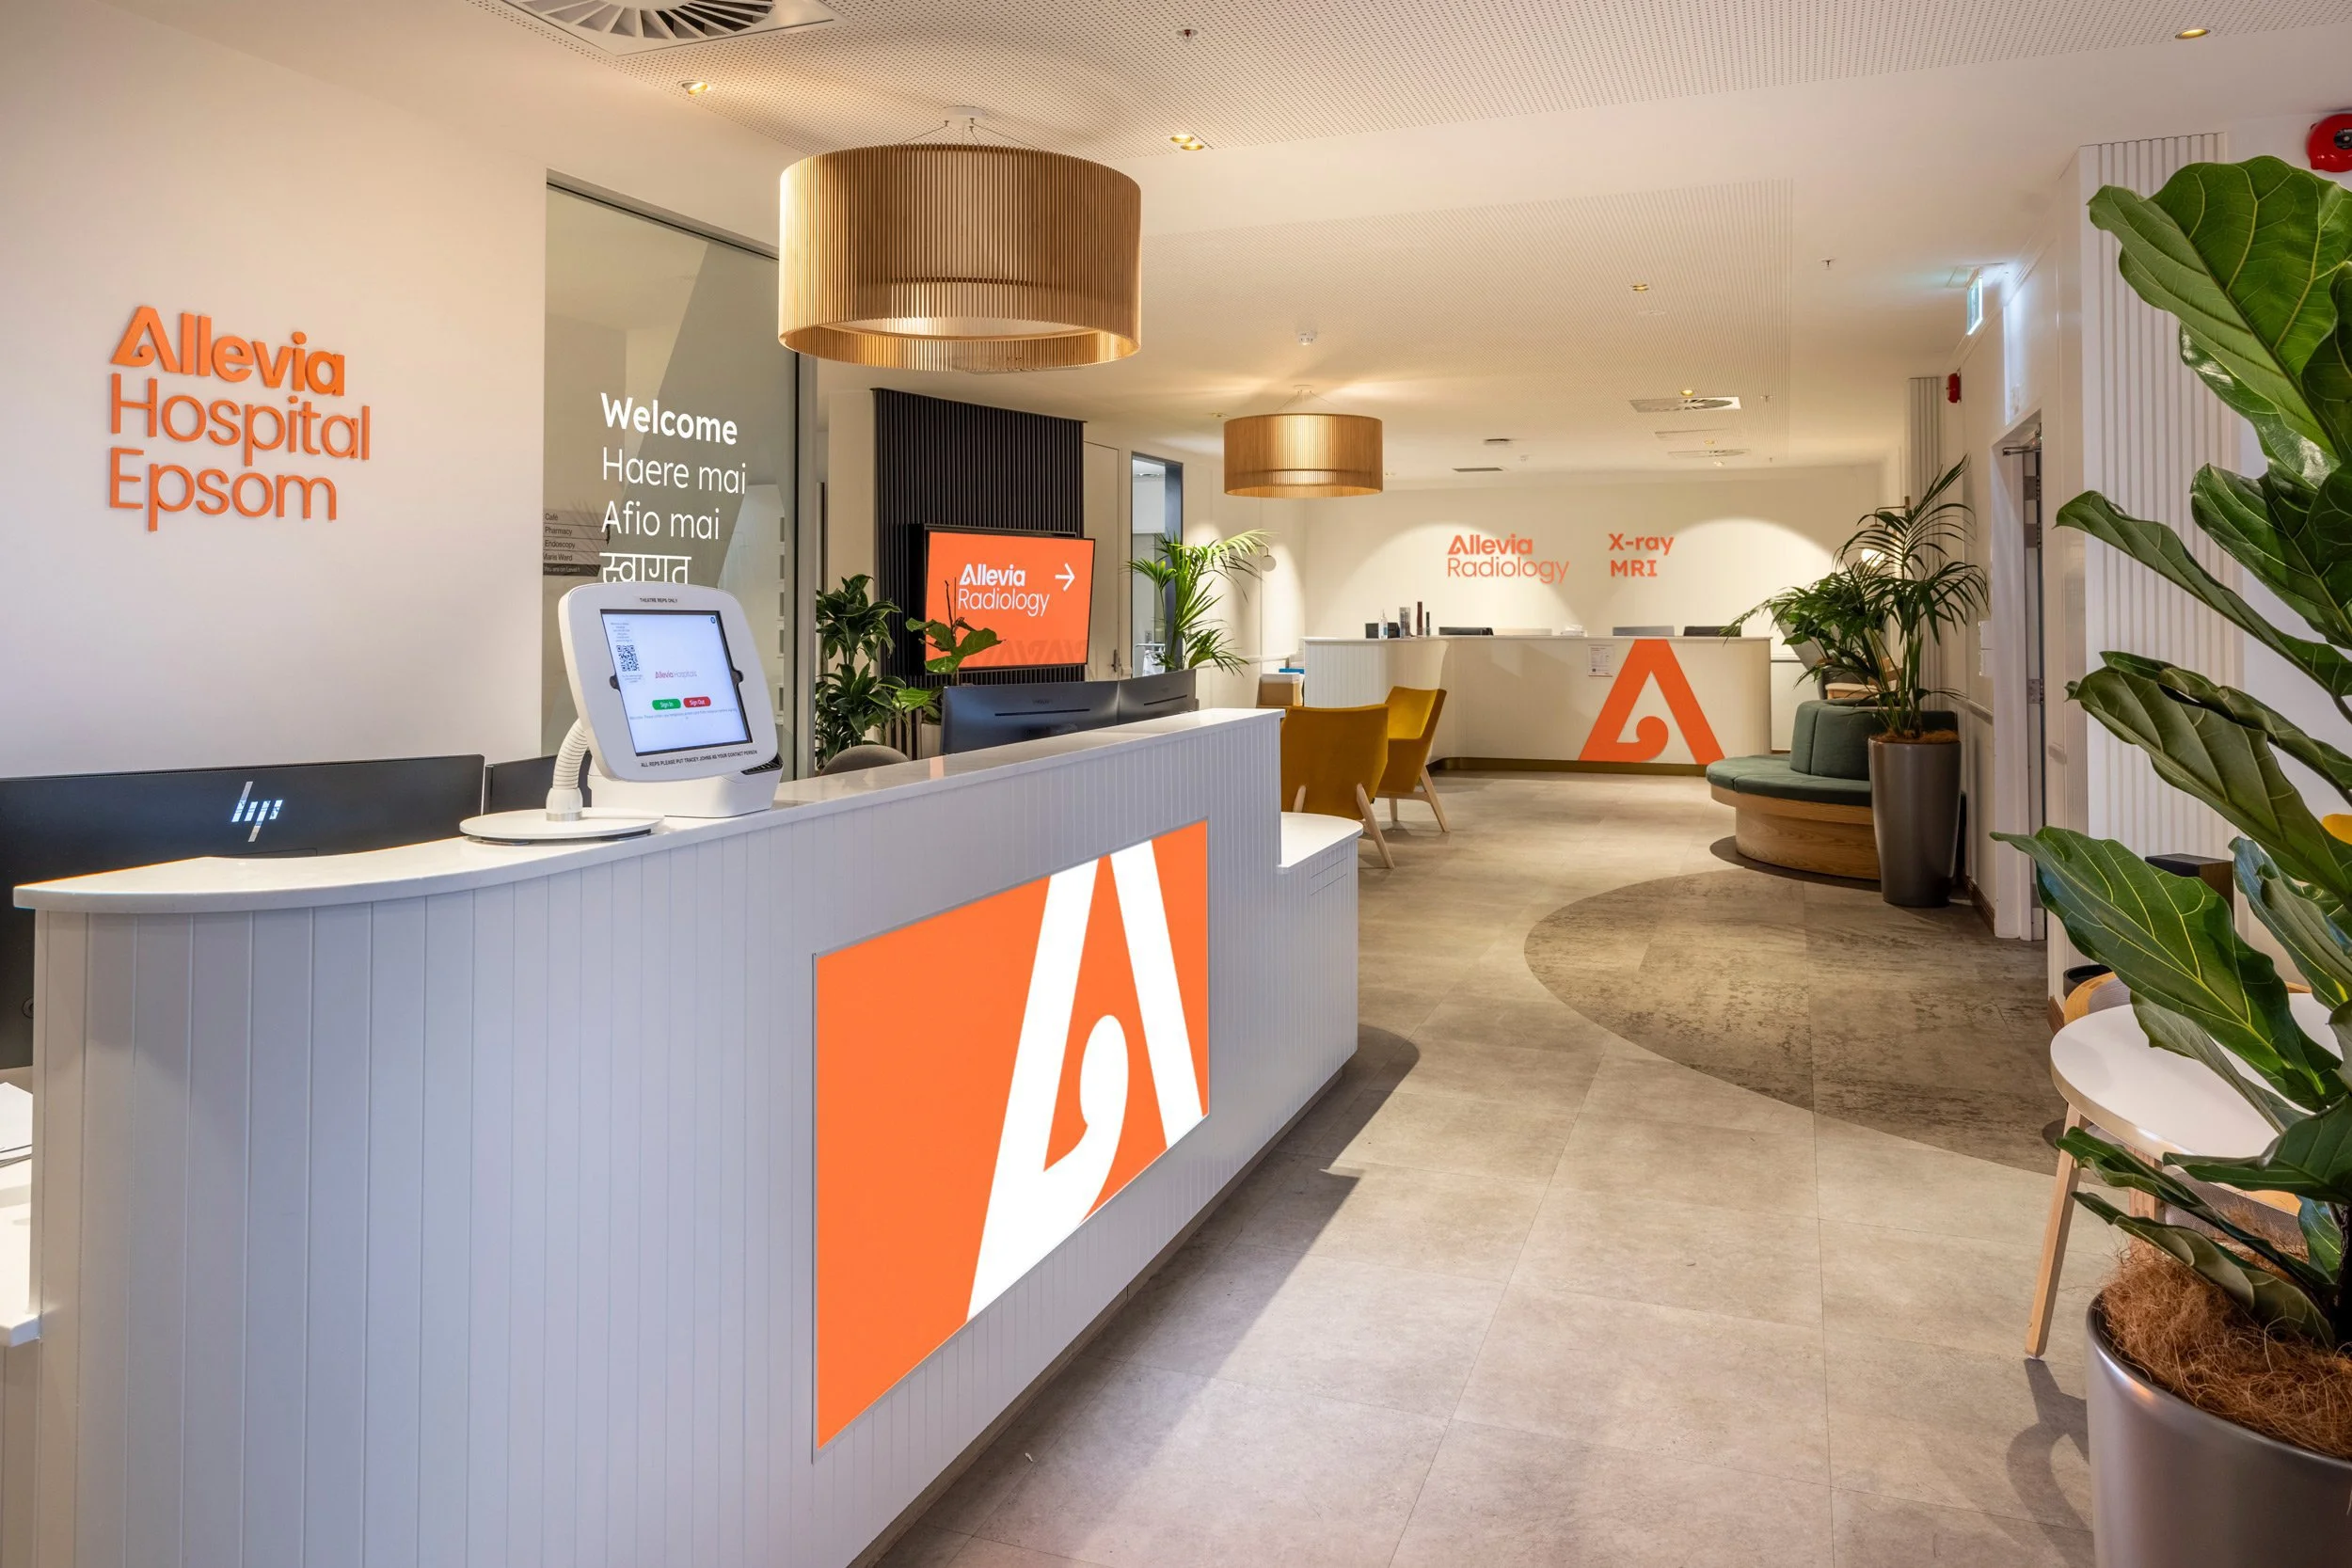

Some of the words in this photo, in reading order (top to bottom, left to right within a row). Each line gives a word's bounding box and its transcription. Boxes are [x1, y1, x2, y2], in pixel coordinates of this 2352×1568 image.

[109, 306, 345, 397] Allevia
[110, 372, 370, 467] Hospital
[600, 392, 738, 445] Welcome
[603, 447, 690, 488] Haere
[698, 463, 745, 494] mai
[109, 447, 337, 531] Epsom
[545, 527, 572, 536] Pharmacy
[601, 500, 660, 536] Afio
[670, 507, 719, 540] mai
[545, 540, 575, 549] Endoscopy
[1447, 533, 1533, 555] Allevia
[1609, 533, 1675, 556] X-ray
[960, 563, 1025, 587] Allevia
[1447, 557, 1569, 584] Radiology
[1611, 560, 1658, 578] MRI
[958, 588, 1050, 617] Radiology
[231, 782, 283, 842] hp
